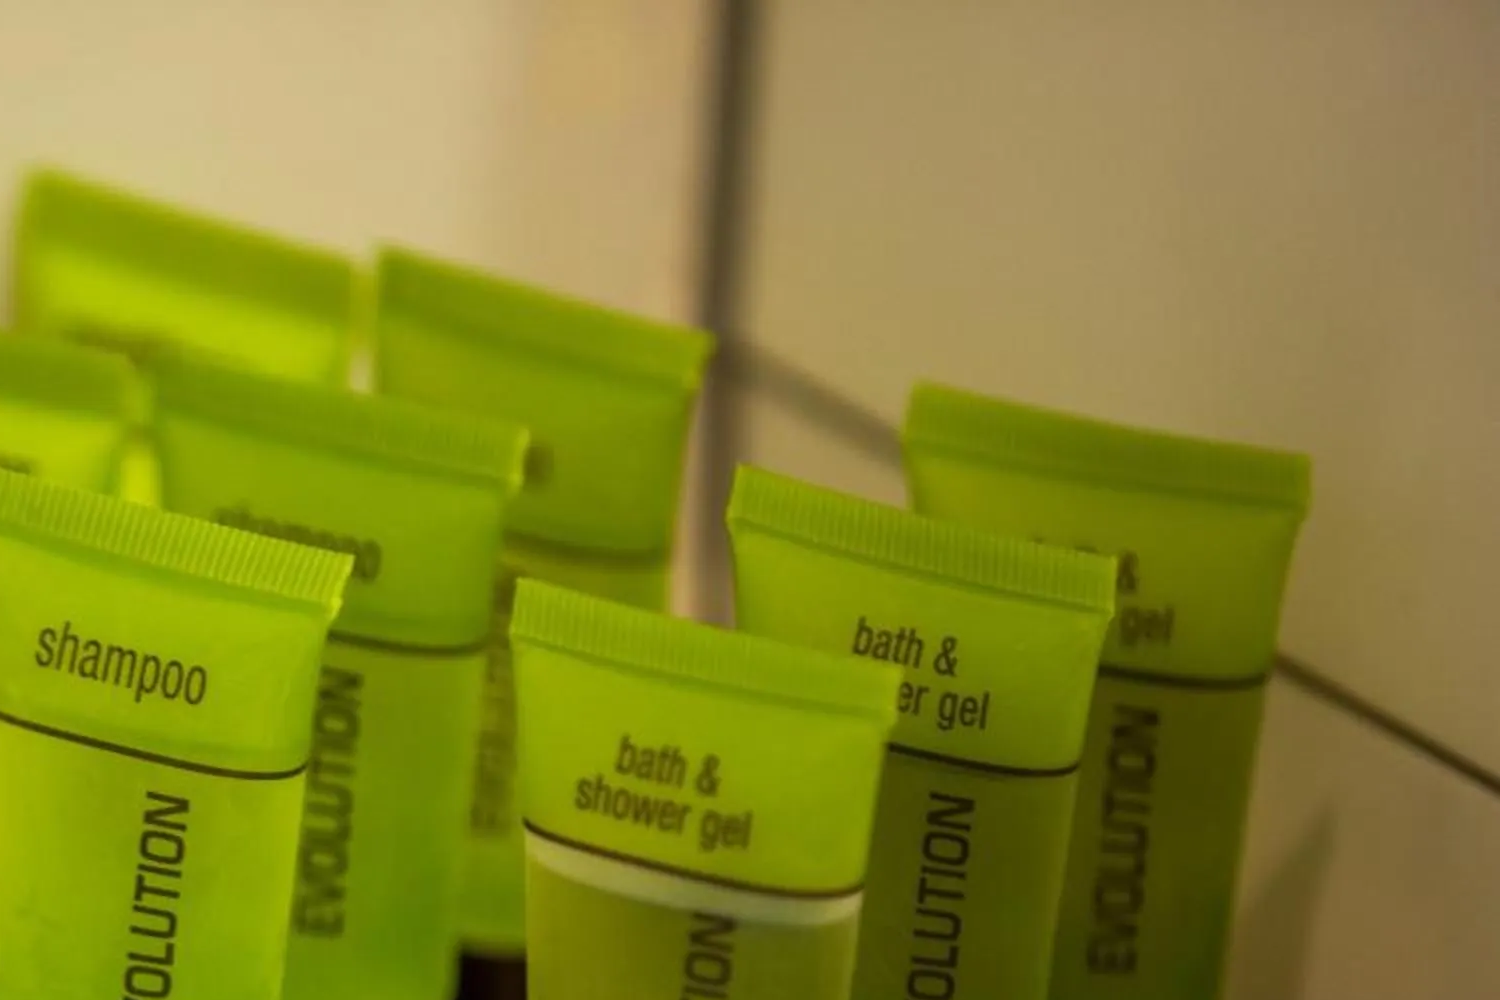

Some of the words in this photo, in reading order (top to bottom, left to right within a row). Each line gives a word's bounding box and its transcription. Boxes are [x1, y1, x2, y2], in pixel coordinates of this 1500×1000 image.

[34, 620, 208, 706] shampoo
[853, 616, 924, 669] bath
[933, 636, 958, 677] &
[937, 690, 990, 731] gel
[295, 667, 365, 938] EVOLUTION
[615, 733, 688, 790] bath
[696, 754, 722, 798] &
[574, 773, 692, 836] shower
[700, 809, 753, 852] gel
[1087, 704, 1160, 976] EVOLUTION
